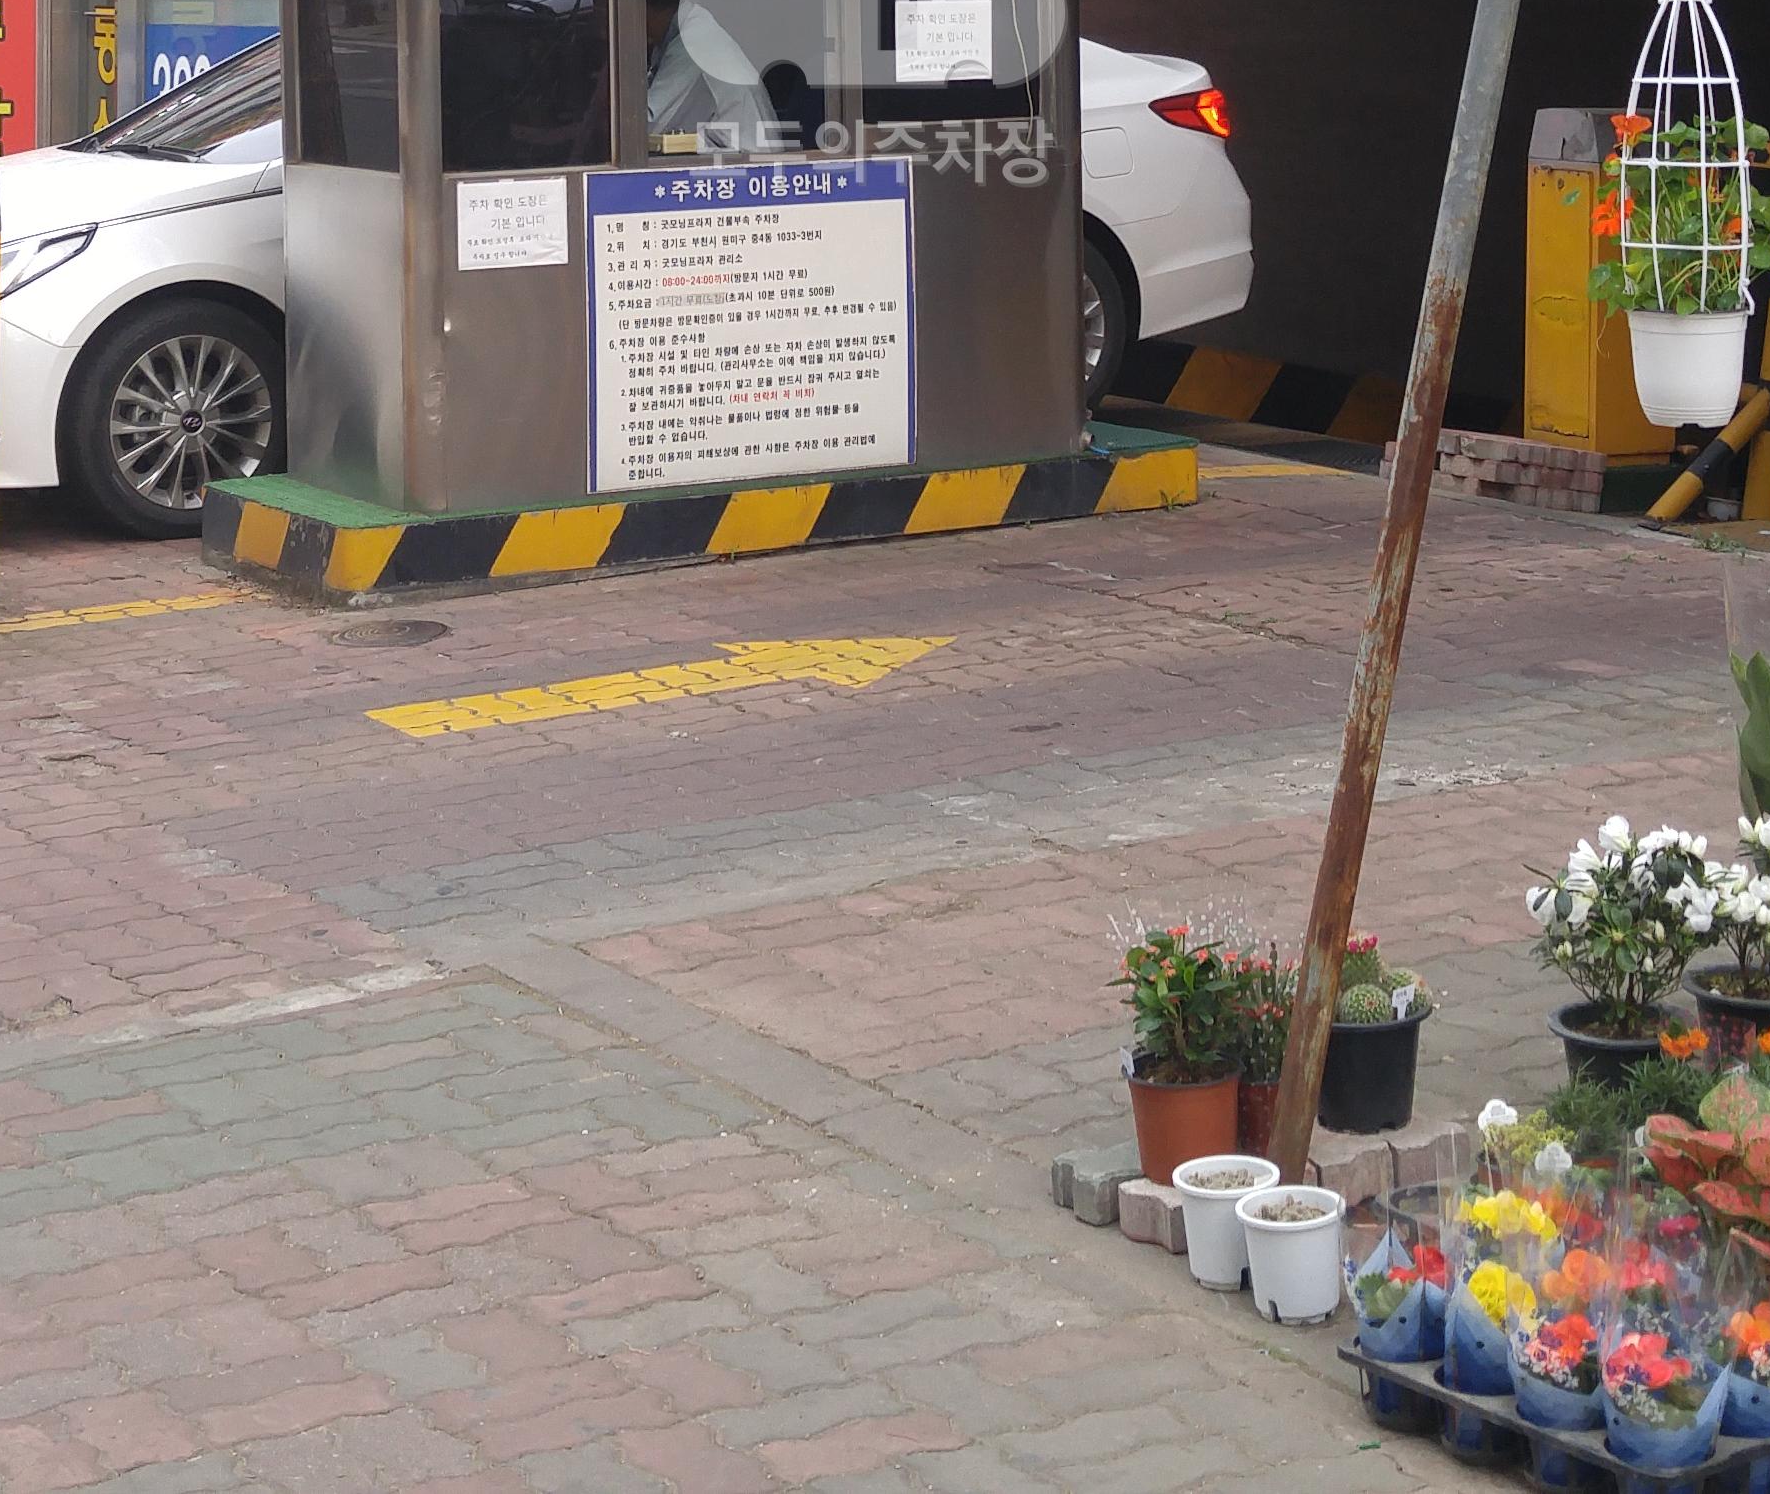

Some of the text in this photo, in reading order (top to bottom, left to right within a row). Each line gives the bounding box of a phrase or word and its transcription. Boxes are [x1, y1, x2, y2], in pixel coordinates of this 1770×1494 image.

[670, 174, 832, 203] 주차장 이용안내
[660, 237, 687, 250] 경기도
[718, 253, 743, 266] 관리소
